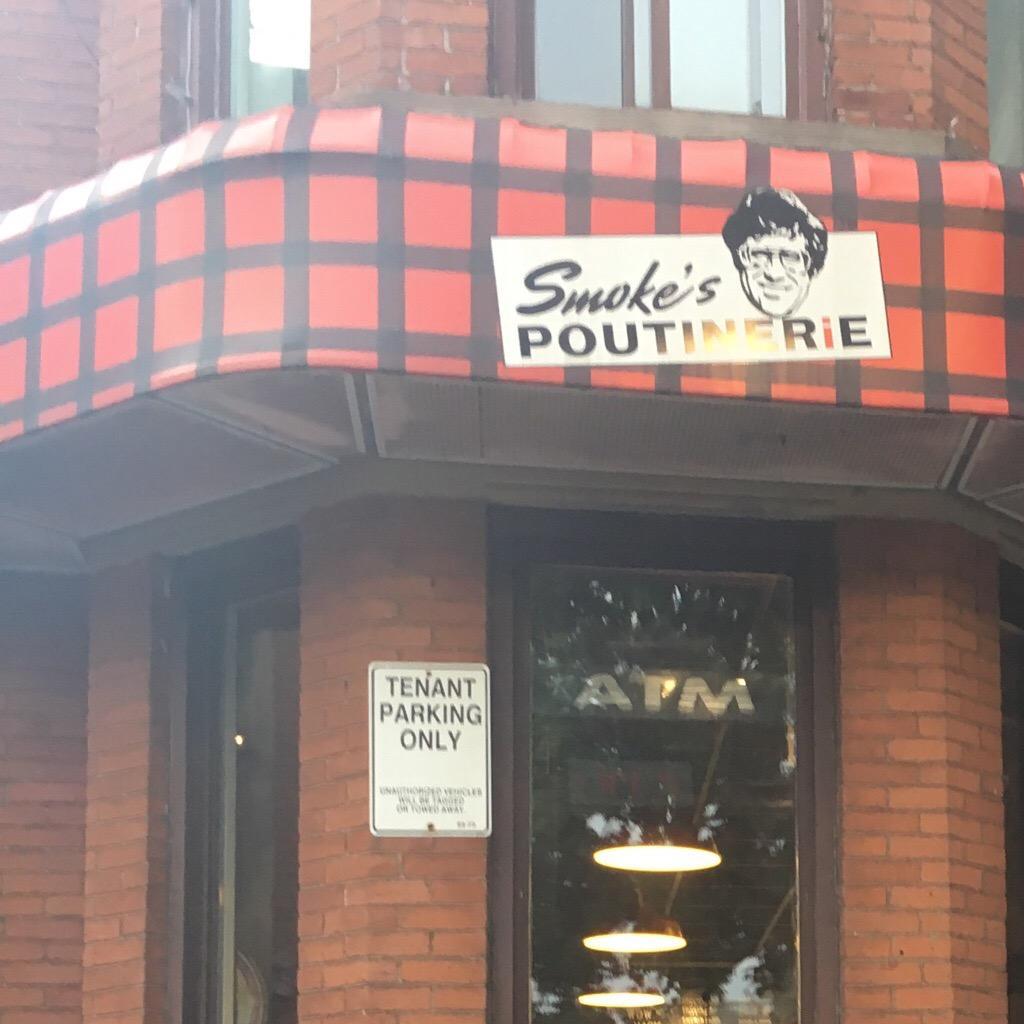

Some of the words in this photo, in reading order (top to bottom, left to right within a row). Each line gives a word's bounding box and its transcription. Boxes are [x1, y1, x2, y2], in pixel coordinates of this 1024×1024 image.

[515, 259, 721, 315] Smoke's
[385, 676, 476, 699] TENANT
[573, 672, 756, 715] ATM
[380, 703, 482, 726] PARKING
[400, 729, 461, 751] ONLY
